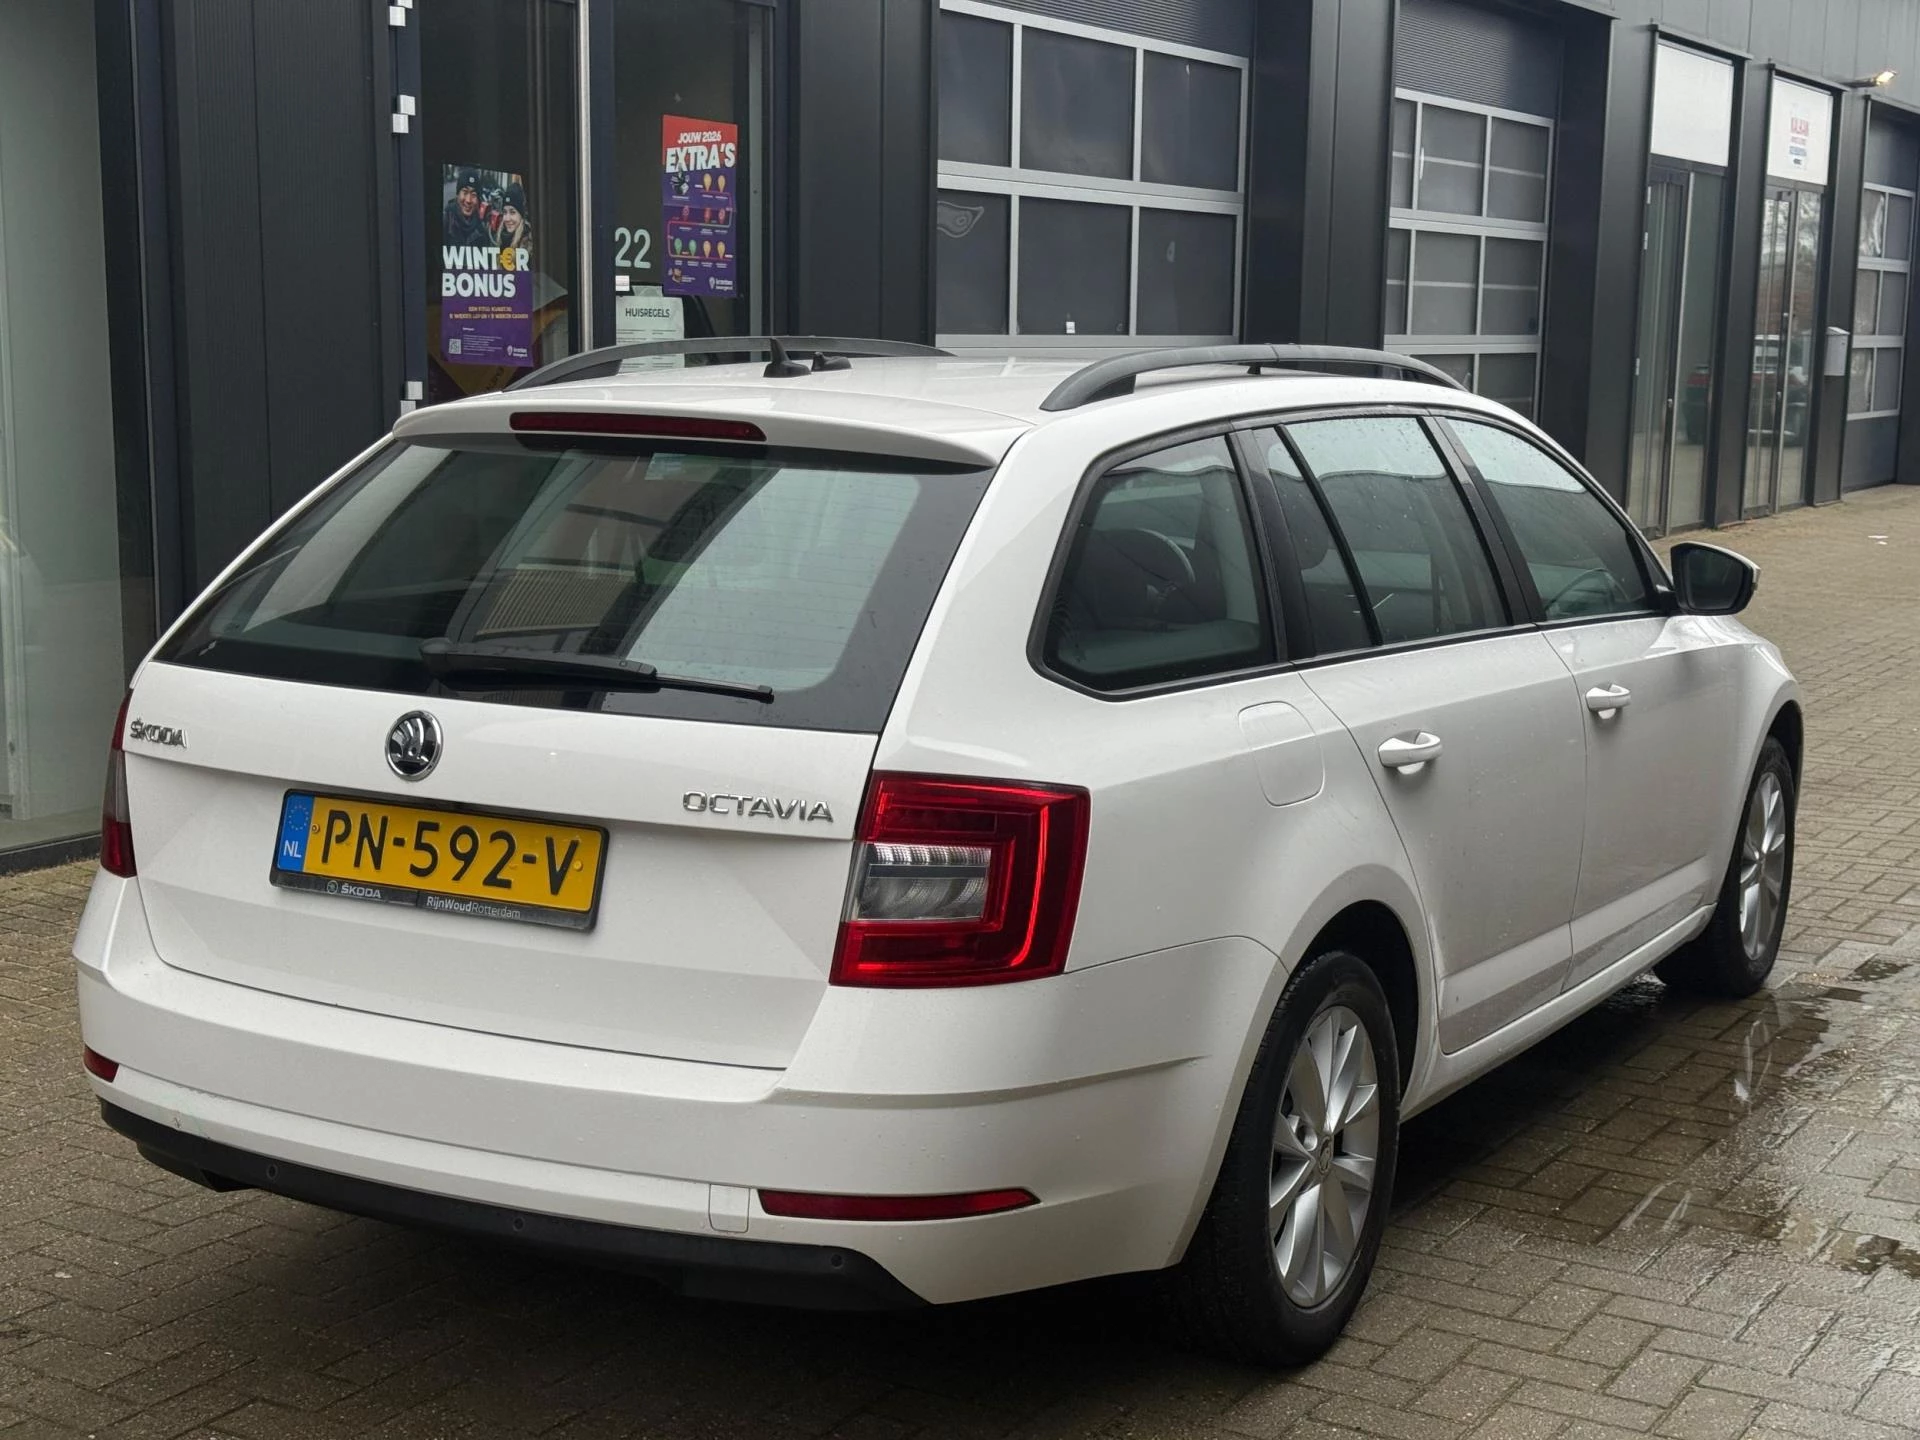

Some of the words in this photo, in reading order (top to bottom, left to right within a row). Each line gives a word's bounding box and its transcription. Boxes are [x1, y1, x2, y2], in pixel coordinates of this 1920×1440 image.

[677, 132, 702, 144] JOUW
[702, 130, 722, 142] 2026
[665, 142, 736, 173] EXTRA'S
[614, 226, 652, 269] 22
[441, 272, 516, 298] BONUS
[625, 307, 670, 318] HUISREGELS
[129, 717, 189, 749] ŠKODA
[682, 790, 834, 823] OCTAVIA
[282, 839, 303, 859] NL
[320, 808, 580, 897] PN-592-V
[340, 881, 382, 900] ŠKODA
